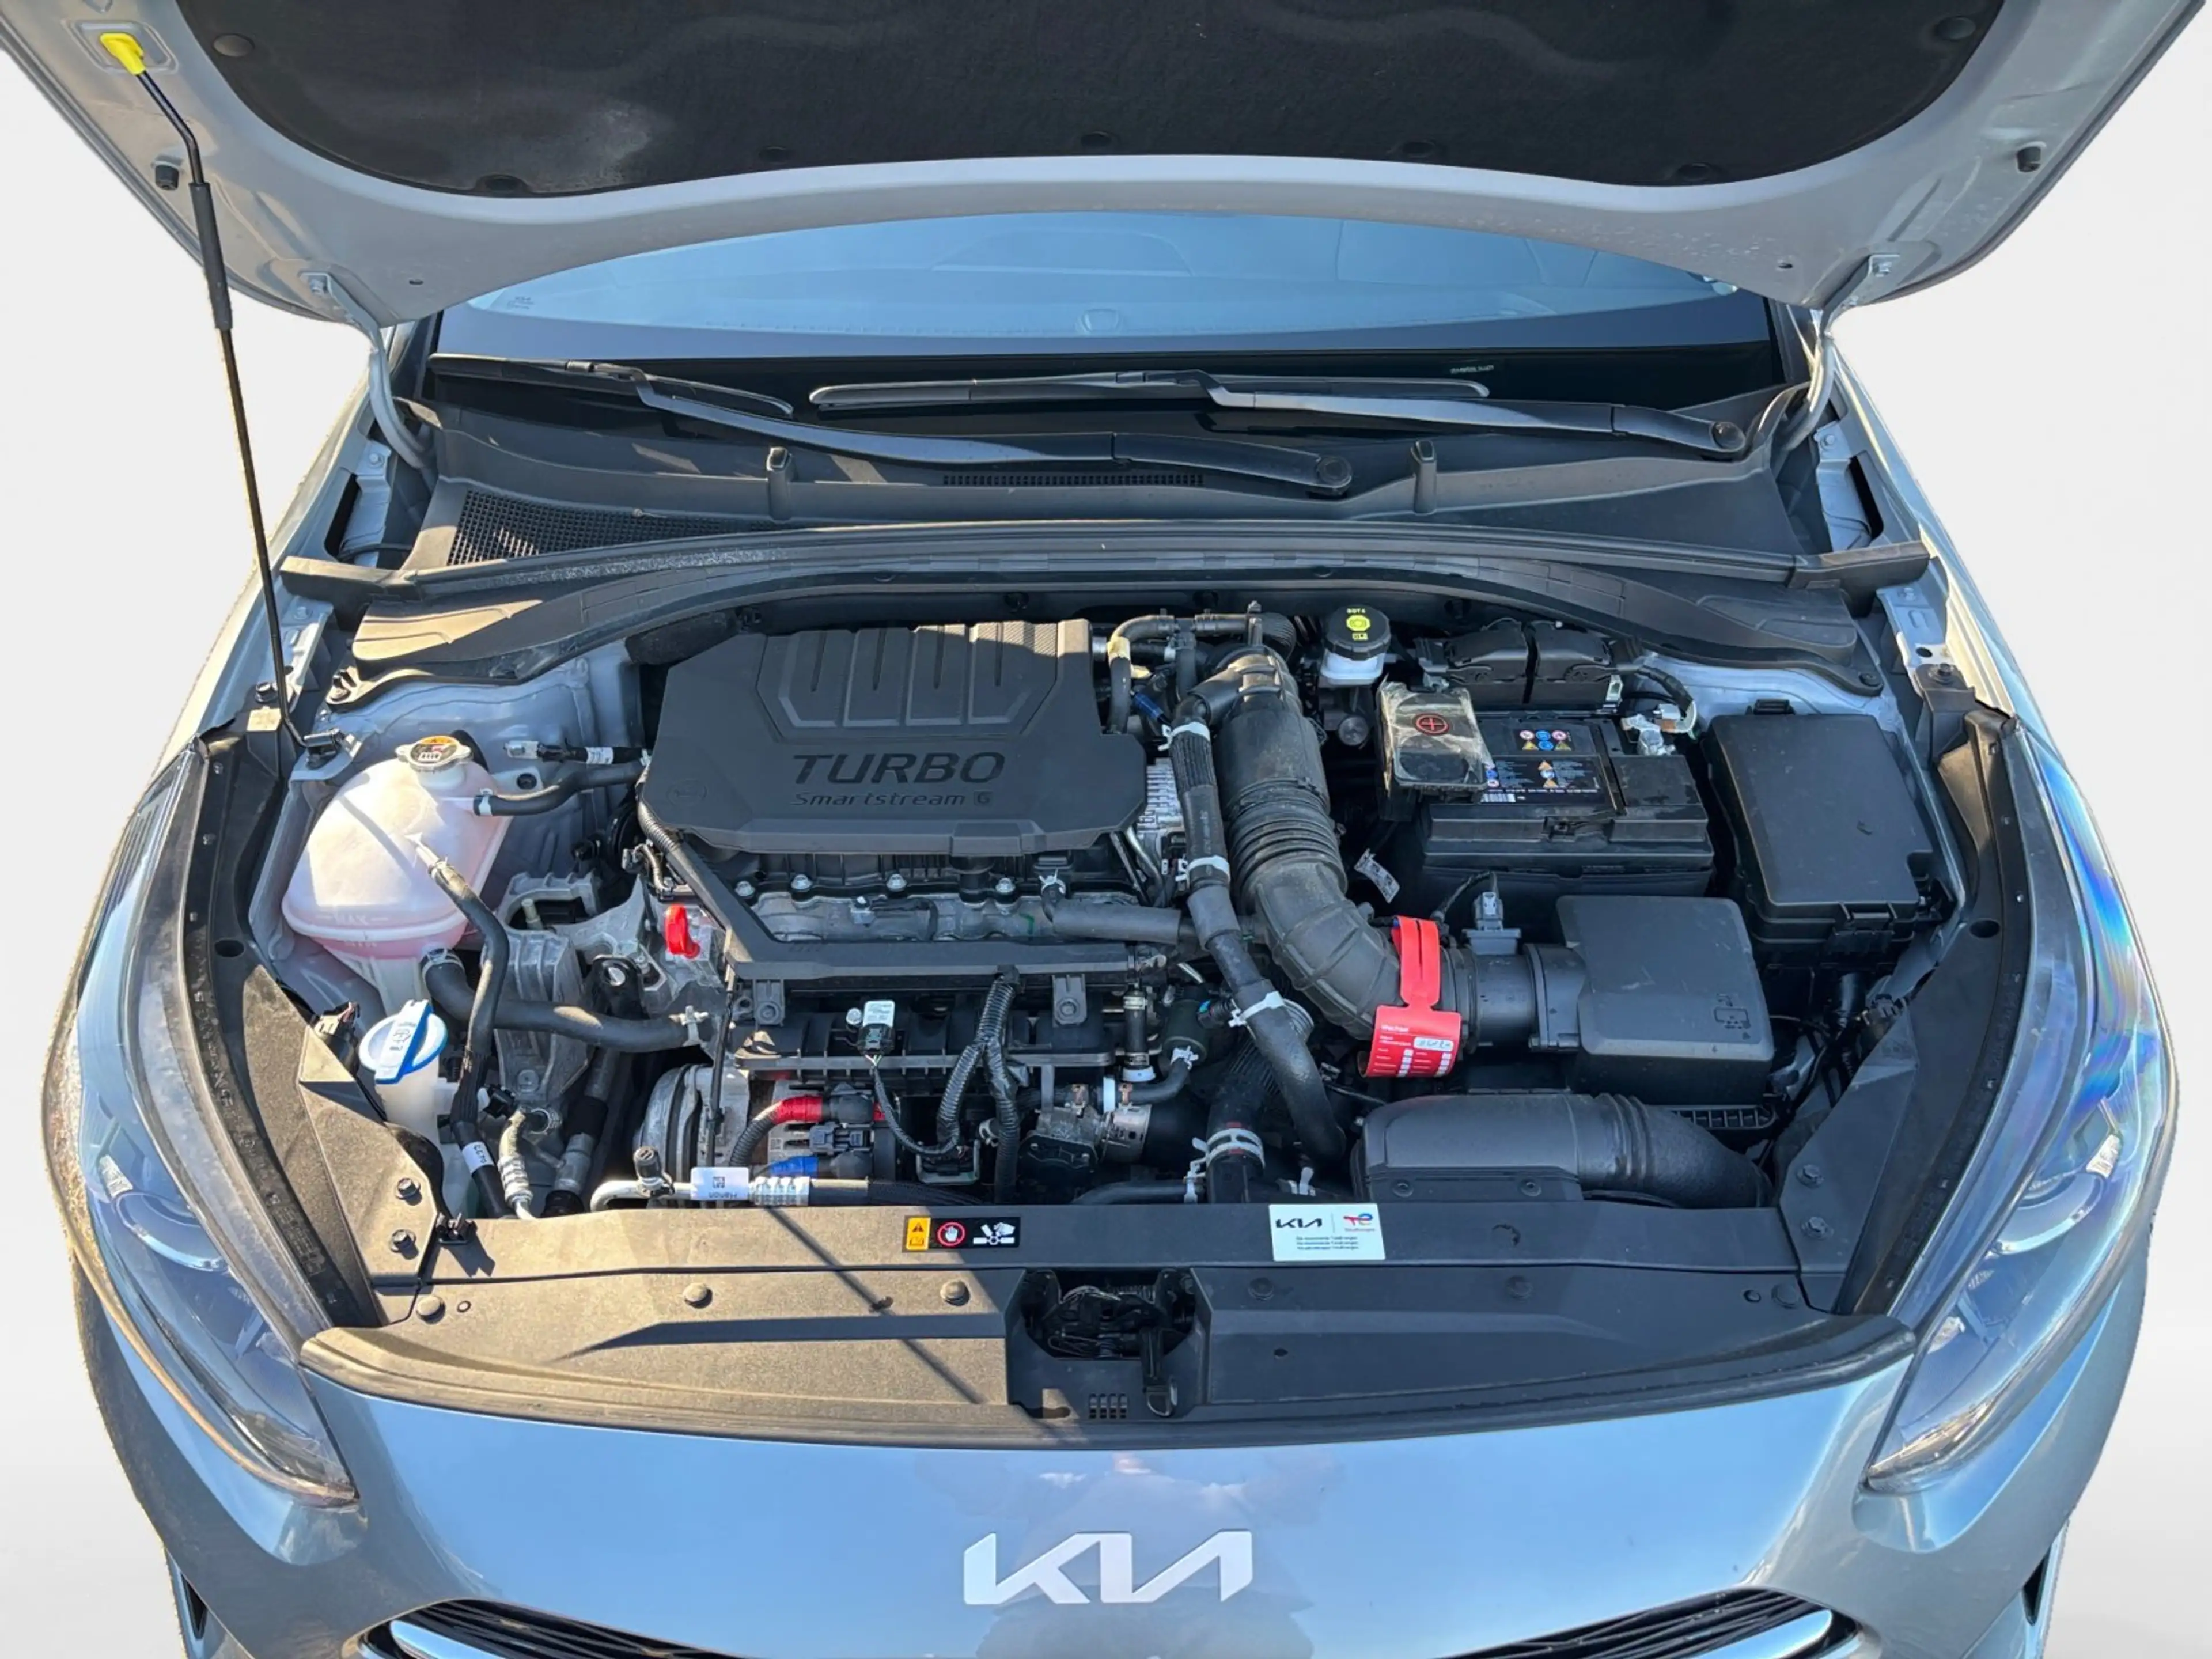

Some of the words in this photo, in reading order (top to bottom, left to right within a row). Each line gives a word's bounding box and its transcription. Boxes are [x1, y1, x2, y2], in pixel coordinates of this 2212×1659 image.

[793, 752, 1005, 784] TURBO
[795, 792, 965, 806] Smartstream
[1275, 1218, 1323, 1228] KIA
[964, 1528, 1253, 1604] KIA
